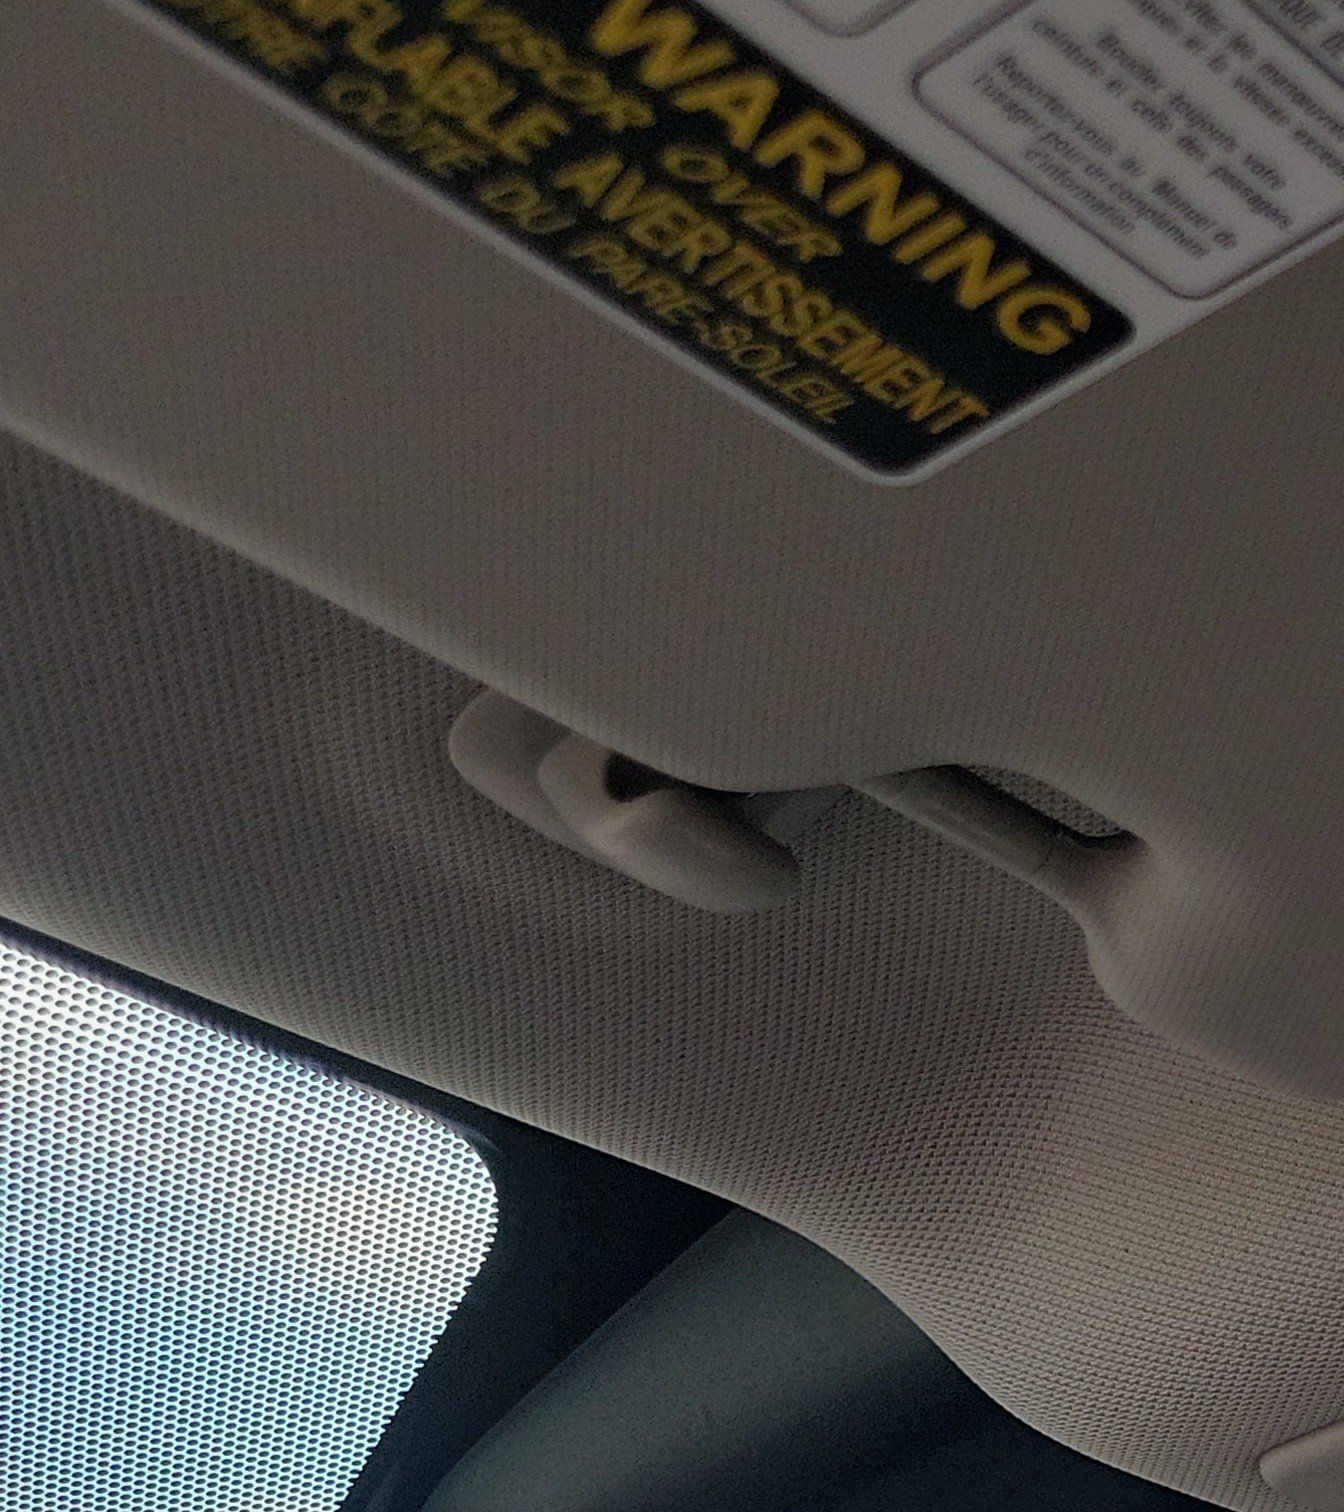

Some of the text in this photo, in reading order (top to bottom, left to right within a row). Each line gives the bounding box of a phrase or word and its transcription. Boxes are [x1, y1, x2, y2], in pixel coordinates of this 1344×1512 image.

[553, 152, 992, 434] AVERTISSEMENT
[586, 0, 1090, 354] WARNING
[660, 142, 844, 263] OVER
[1152, 178, 1218, 232] Manuel
[478, 178, 578, 236] DU
[565, 240, 855, 424] PARE-SOLEIL
